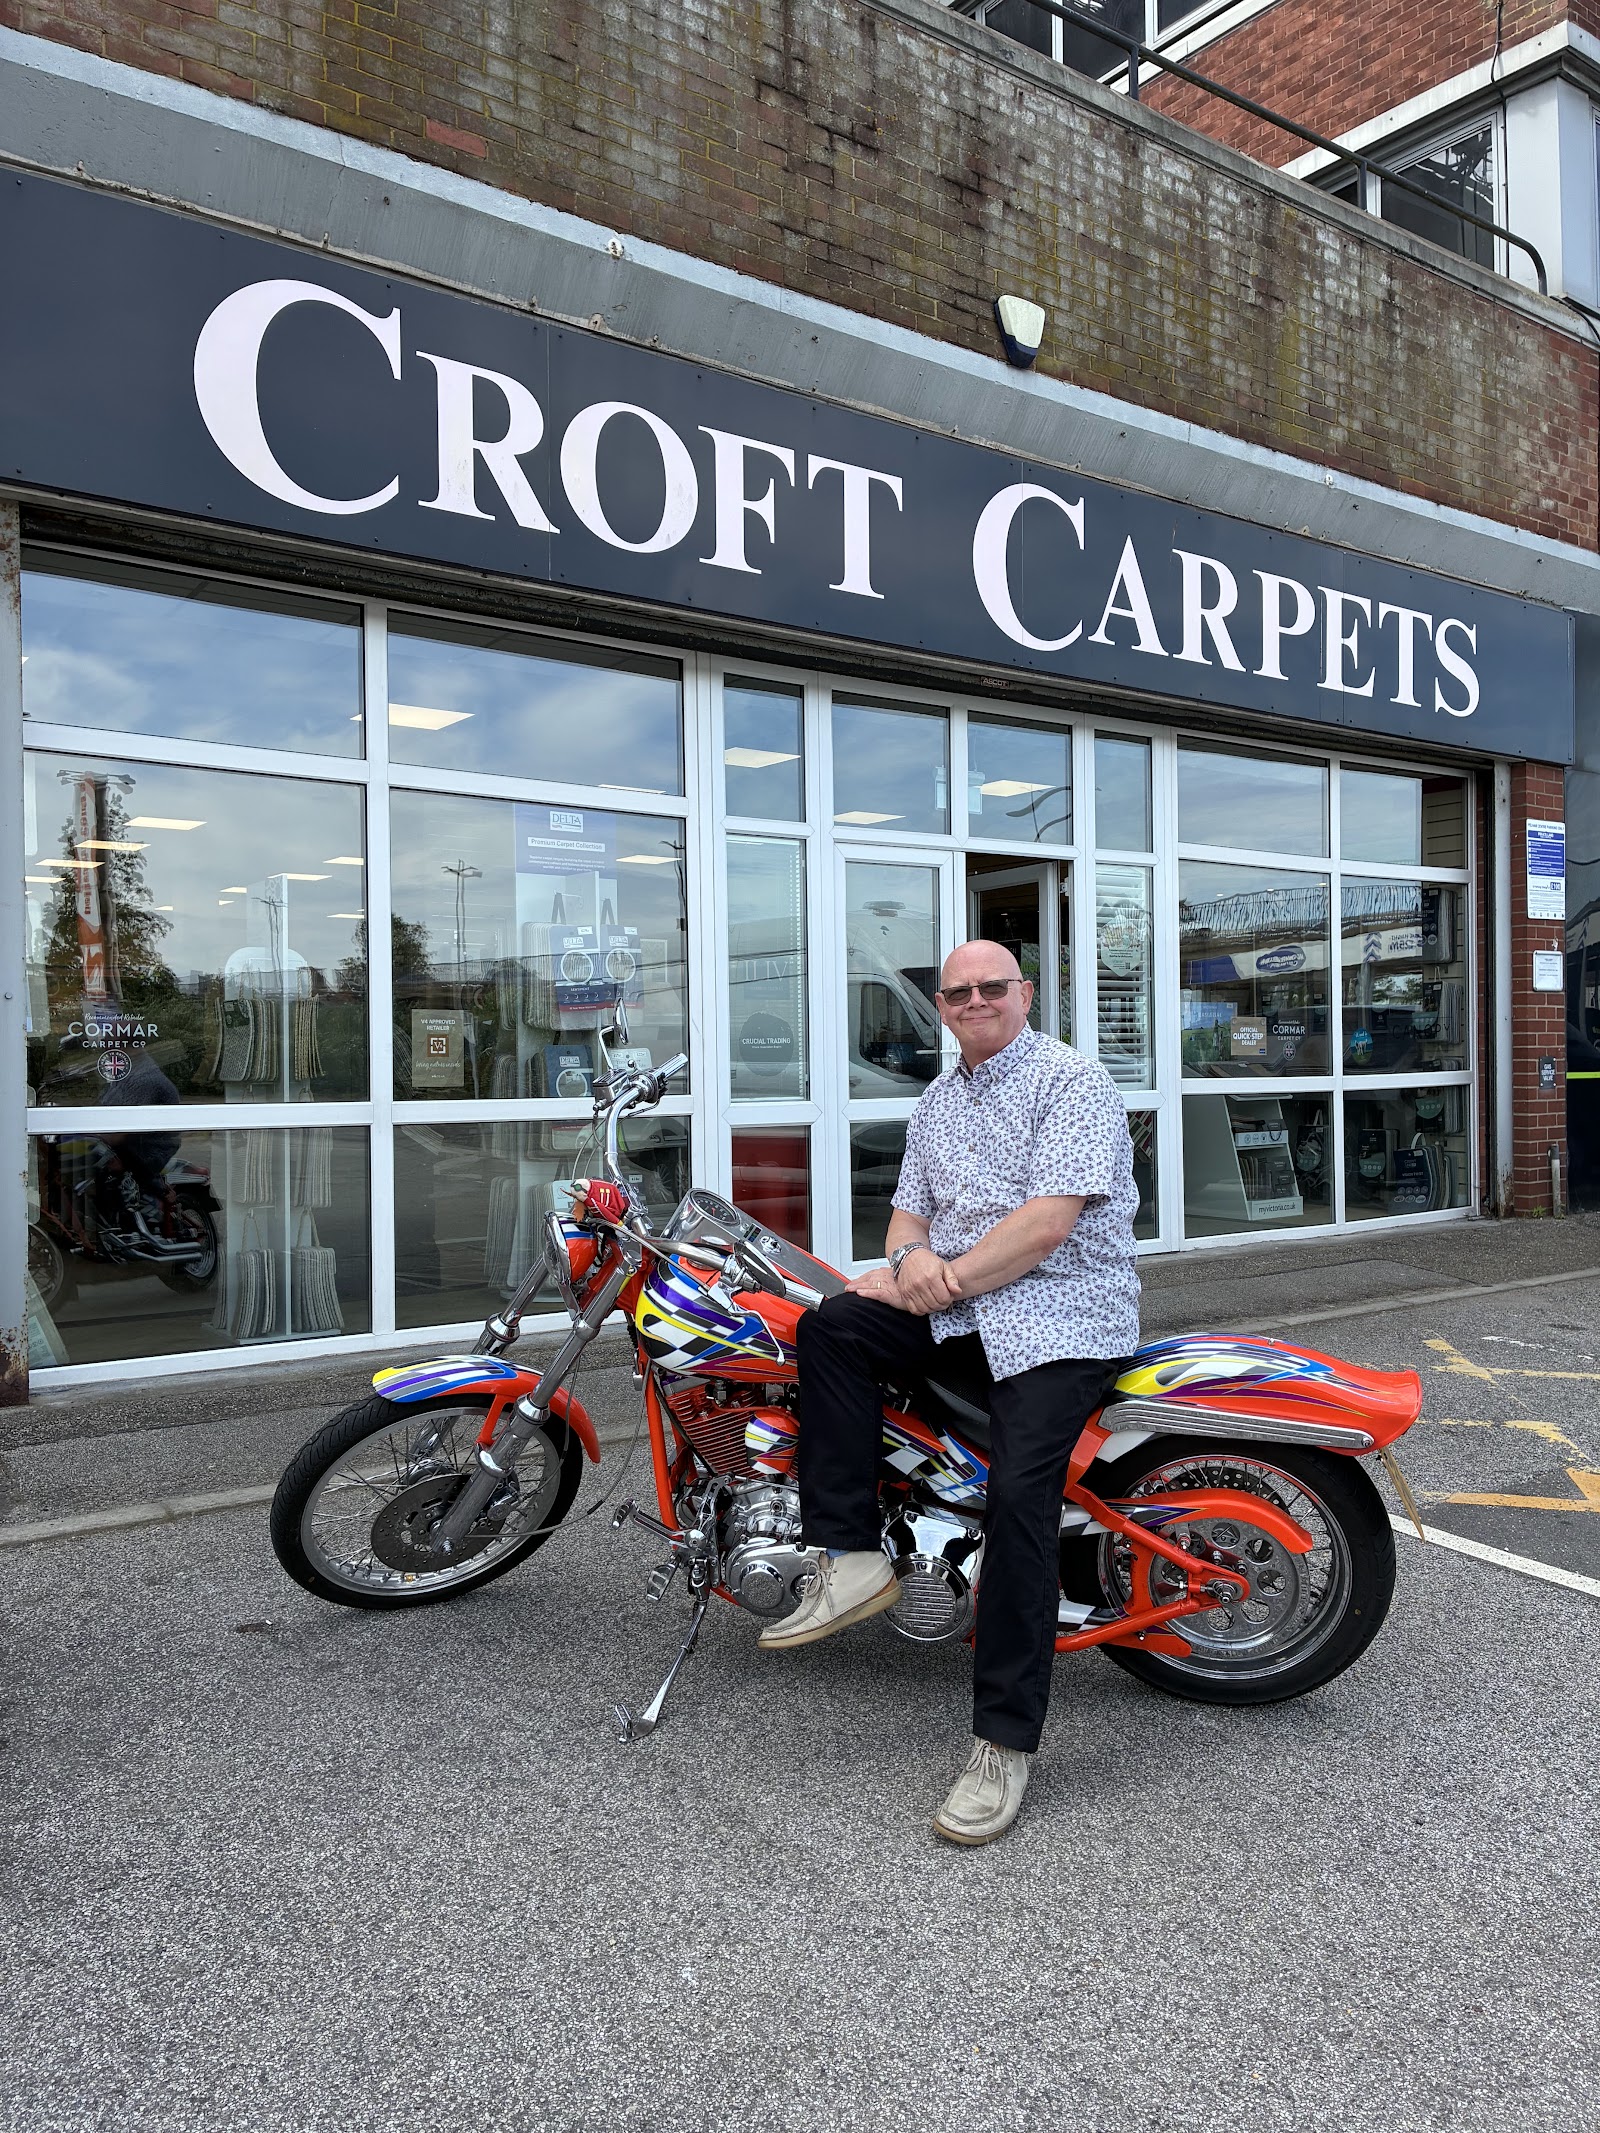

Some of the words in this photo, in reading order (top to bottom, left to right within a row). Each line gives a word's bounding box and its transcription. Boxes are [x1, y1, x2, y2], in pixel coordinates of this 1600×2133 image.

[193, 279, 903, 600] CROFT
[972, 483, 1480, 717] CARPETS
[552, 813, 581, 825] DELTA
[575, 842, 602, 850] Collection
[68, 1021, 159, 1037] CORMAR
[1272, 1024, 1306, 1035] CORMAR
[1258, 1201, 1296, 1215] myvictoria.co.uk
